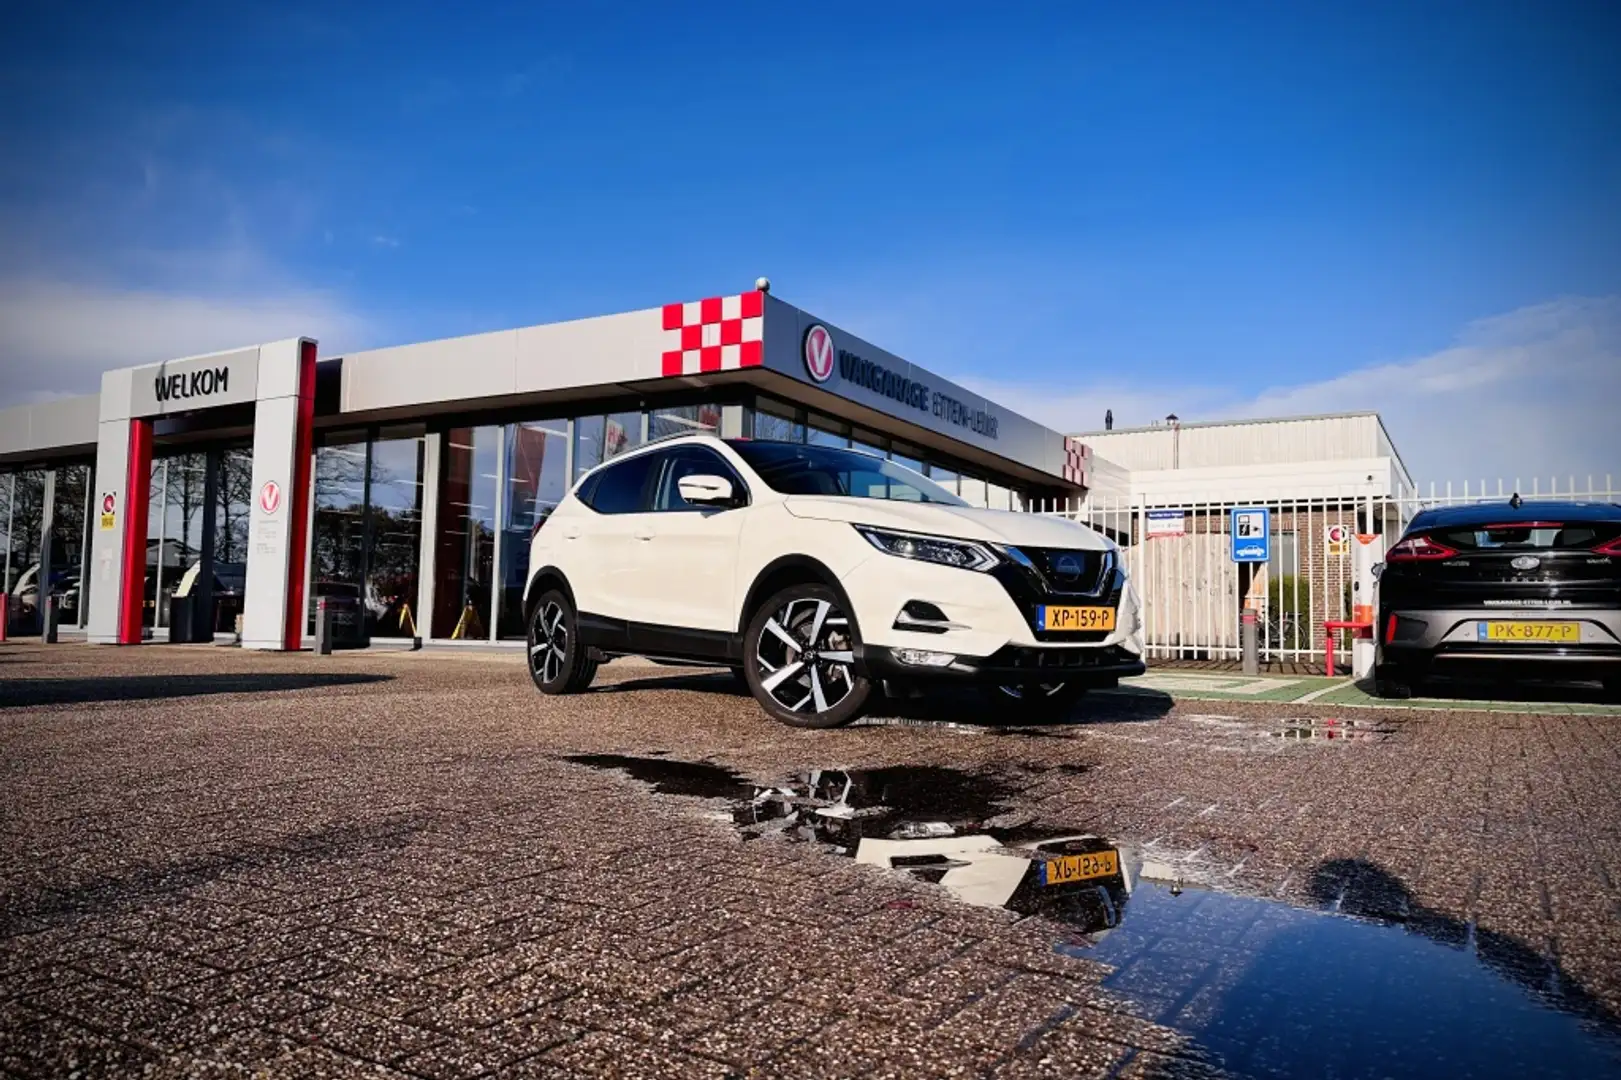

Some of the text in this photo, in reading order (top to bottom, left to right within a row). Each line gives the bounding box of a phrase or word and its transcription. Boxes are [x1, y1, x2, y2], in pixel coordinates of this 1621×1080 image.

[155, 366, 229, 402] WELKOM
[839, 349, 930, 411] VAKGARAGE
[1051, 609, 1110, 627] XP-159-P
[1495, 624, 1572, 638] PK-877-P
